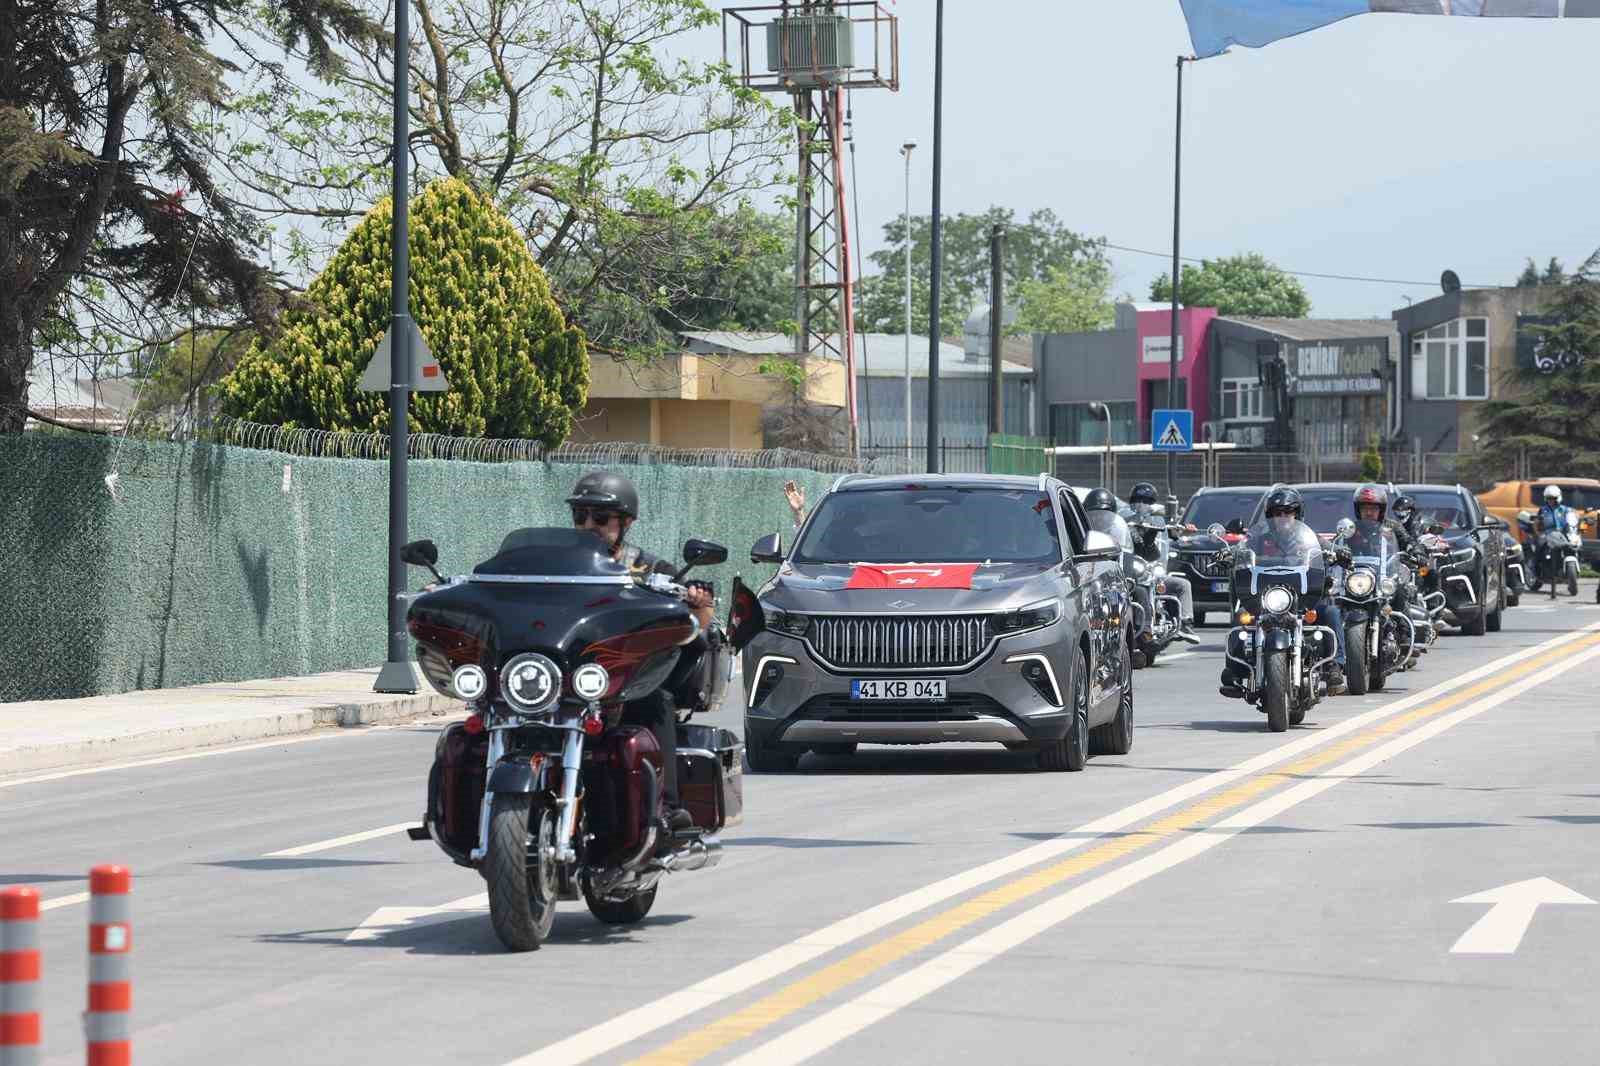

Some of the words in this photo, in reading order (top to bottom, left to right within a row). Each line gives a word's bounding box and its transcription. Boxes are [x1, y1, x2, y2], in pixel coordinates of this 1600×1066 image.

[860, 682, 879, 697] 41
[884, 682, 908, 697] KB
[914, 682, 943, 697] 041
